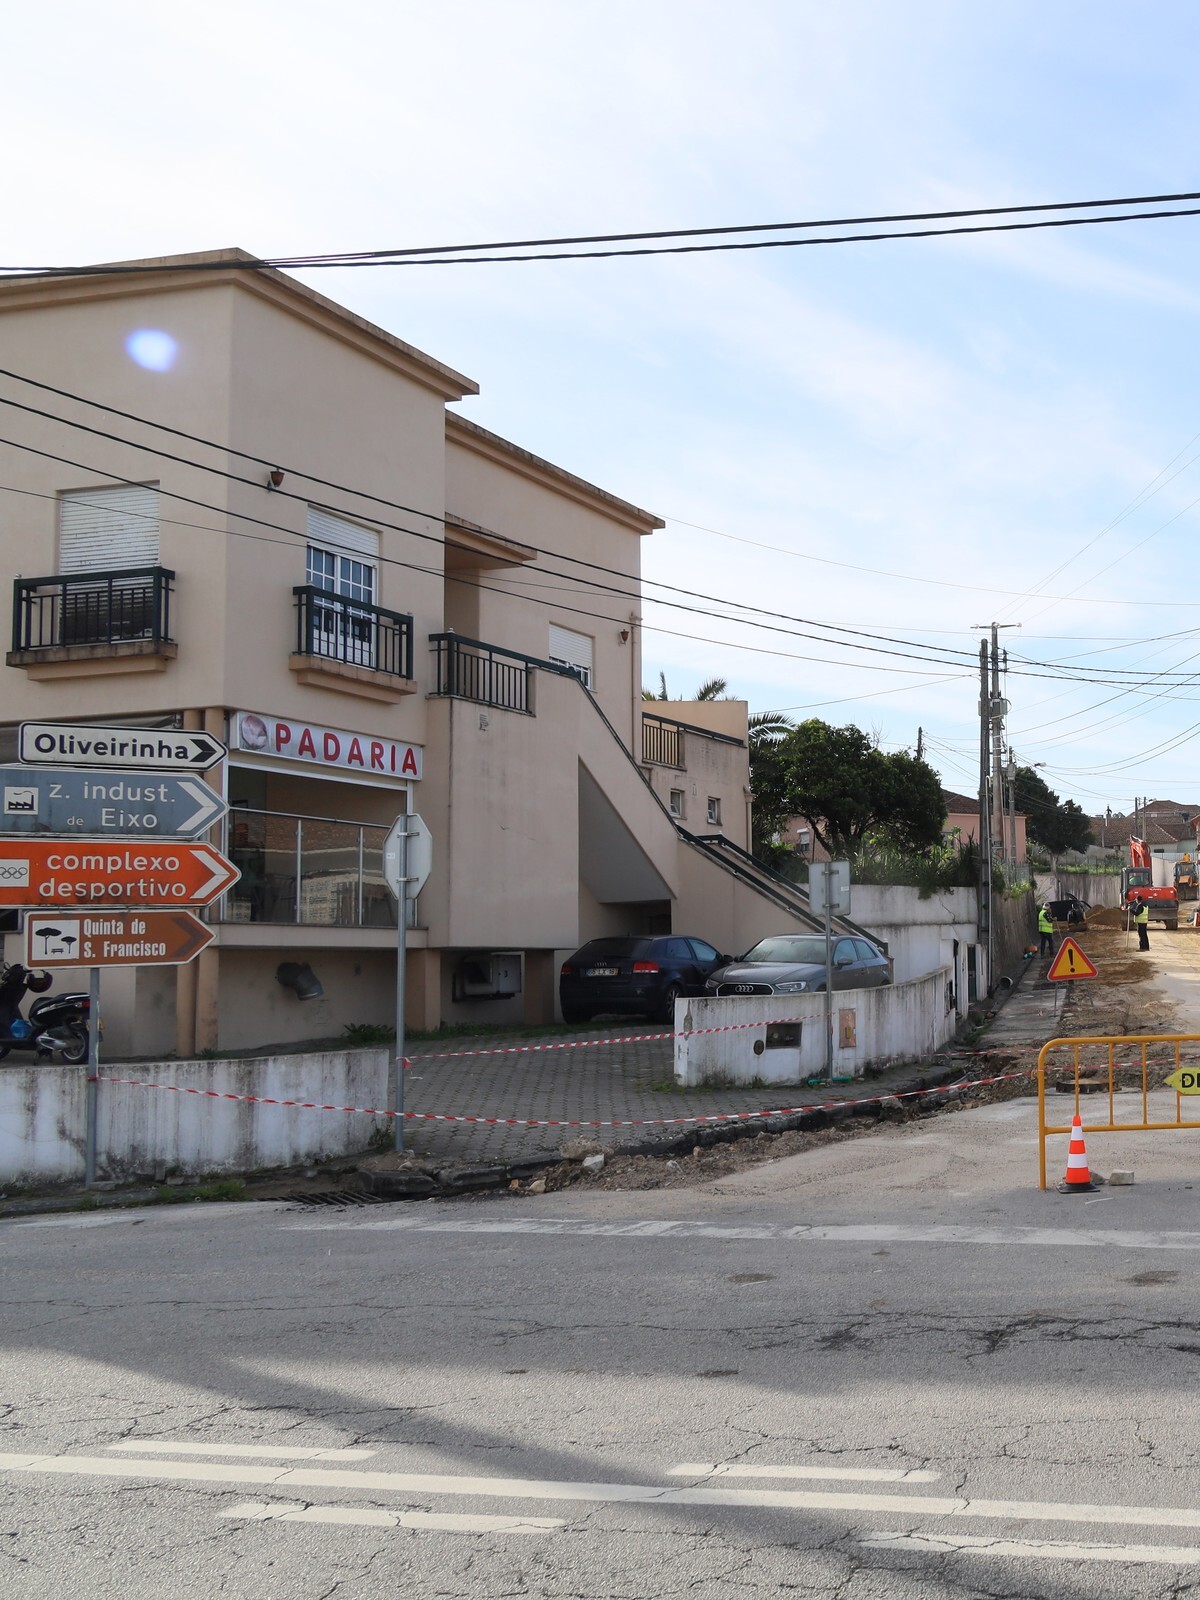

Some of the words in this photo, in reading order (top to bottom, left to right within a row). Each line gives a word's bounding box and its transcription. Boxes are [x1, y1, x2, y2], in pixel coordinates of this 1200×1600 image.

[34, 733, 189, 760] Oliveirinha
[275, 723, 417, 776] PADARIA
[84, 781, 176, 803] indust.
[67, 815, 84, 826] de
[101, 808, 157, 828] Eixo
[47, 851, 180, 874] complexo
[39, 878, 187, 900] desportivo
[83, 918, 124, 938] Quinta
[131, 919, 146, 935] de
[83, 942, 96, 958] S.
[103, 940, 166, 957] Francisco
